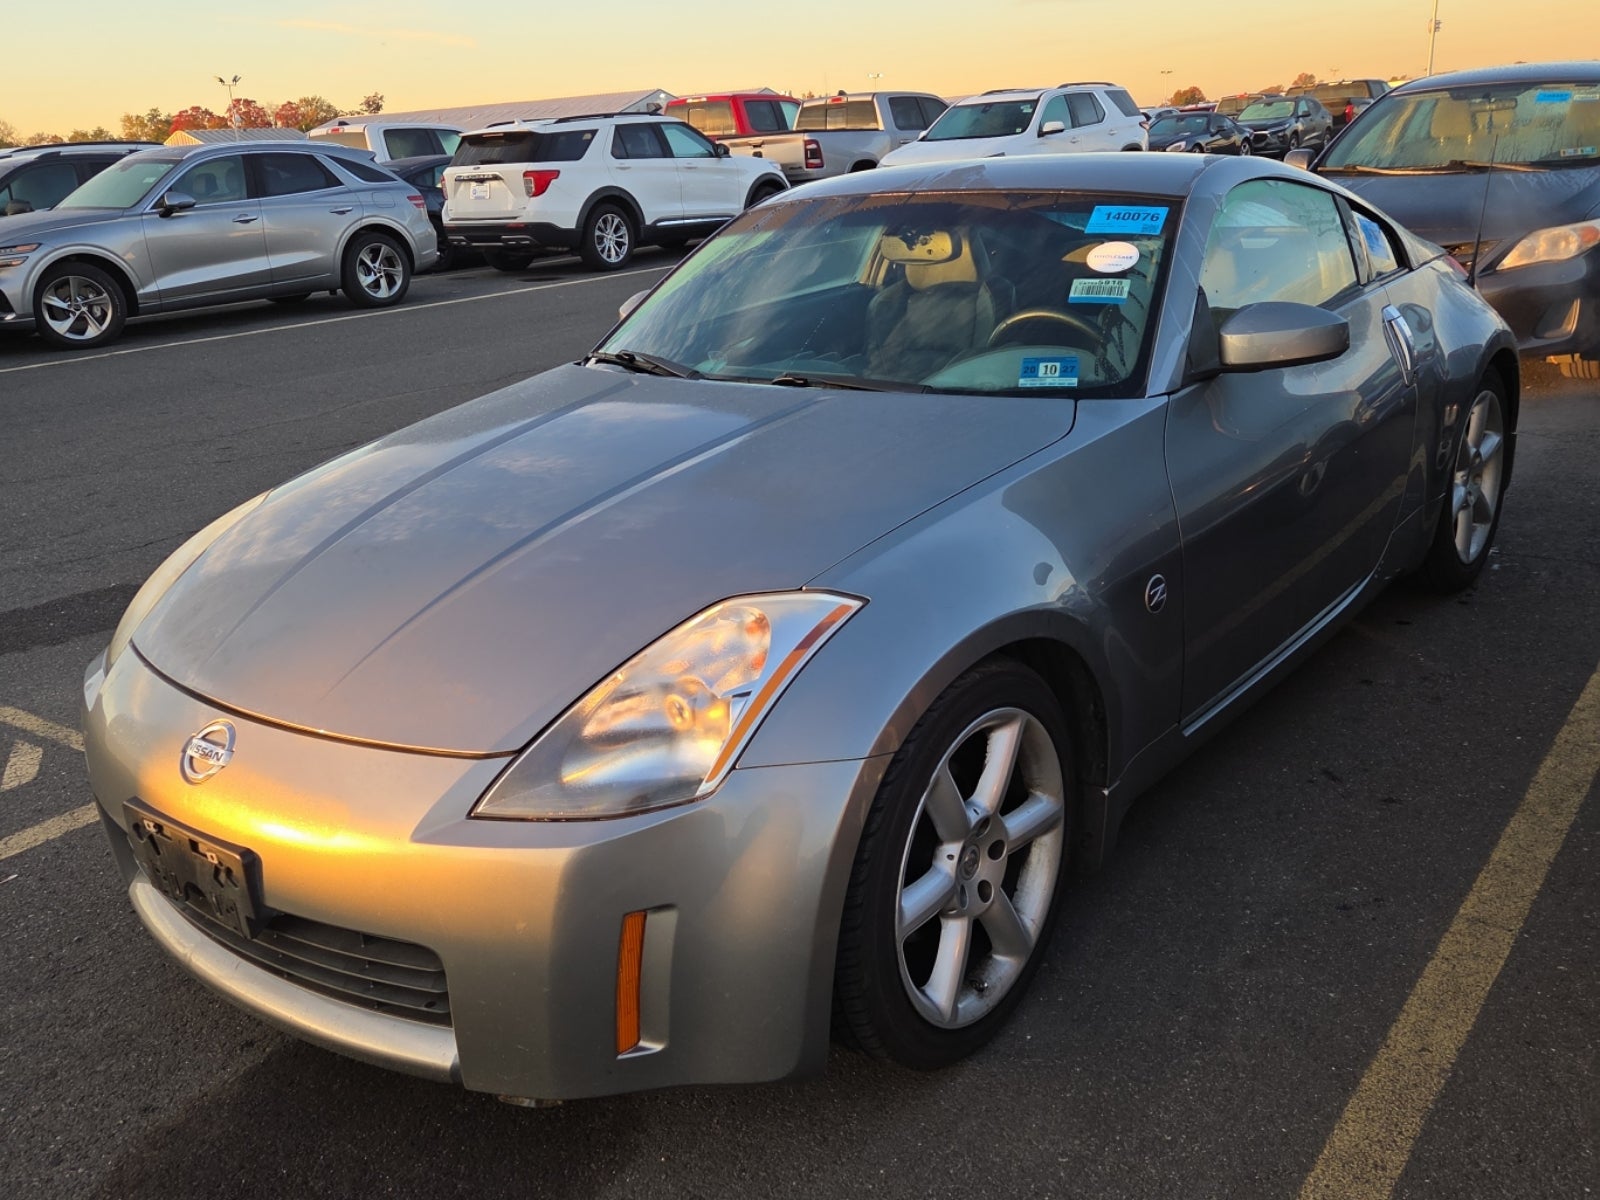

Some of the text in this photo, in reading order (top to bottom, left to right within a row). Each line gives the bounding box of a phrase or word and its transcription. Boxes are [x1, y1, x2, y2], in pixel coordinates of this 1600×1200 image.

[1104, 211, 1161, 222] 140076
[1042, 364, 1058, 375] 10
[188, 742, 225, 762] NISSAN
